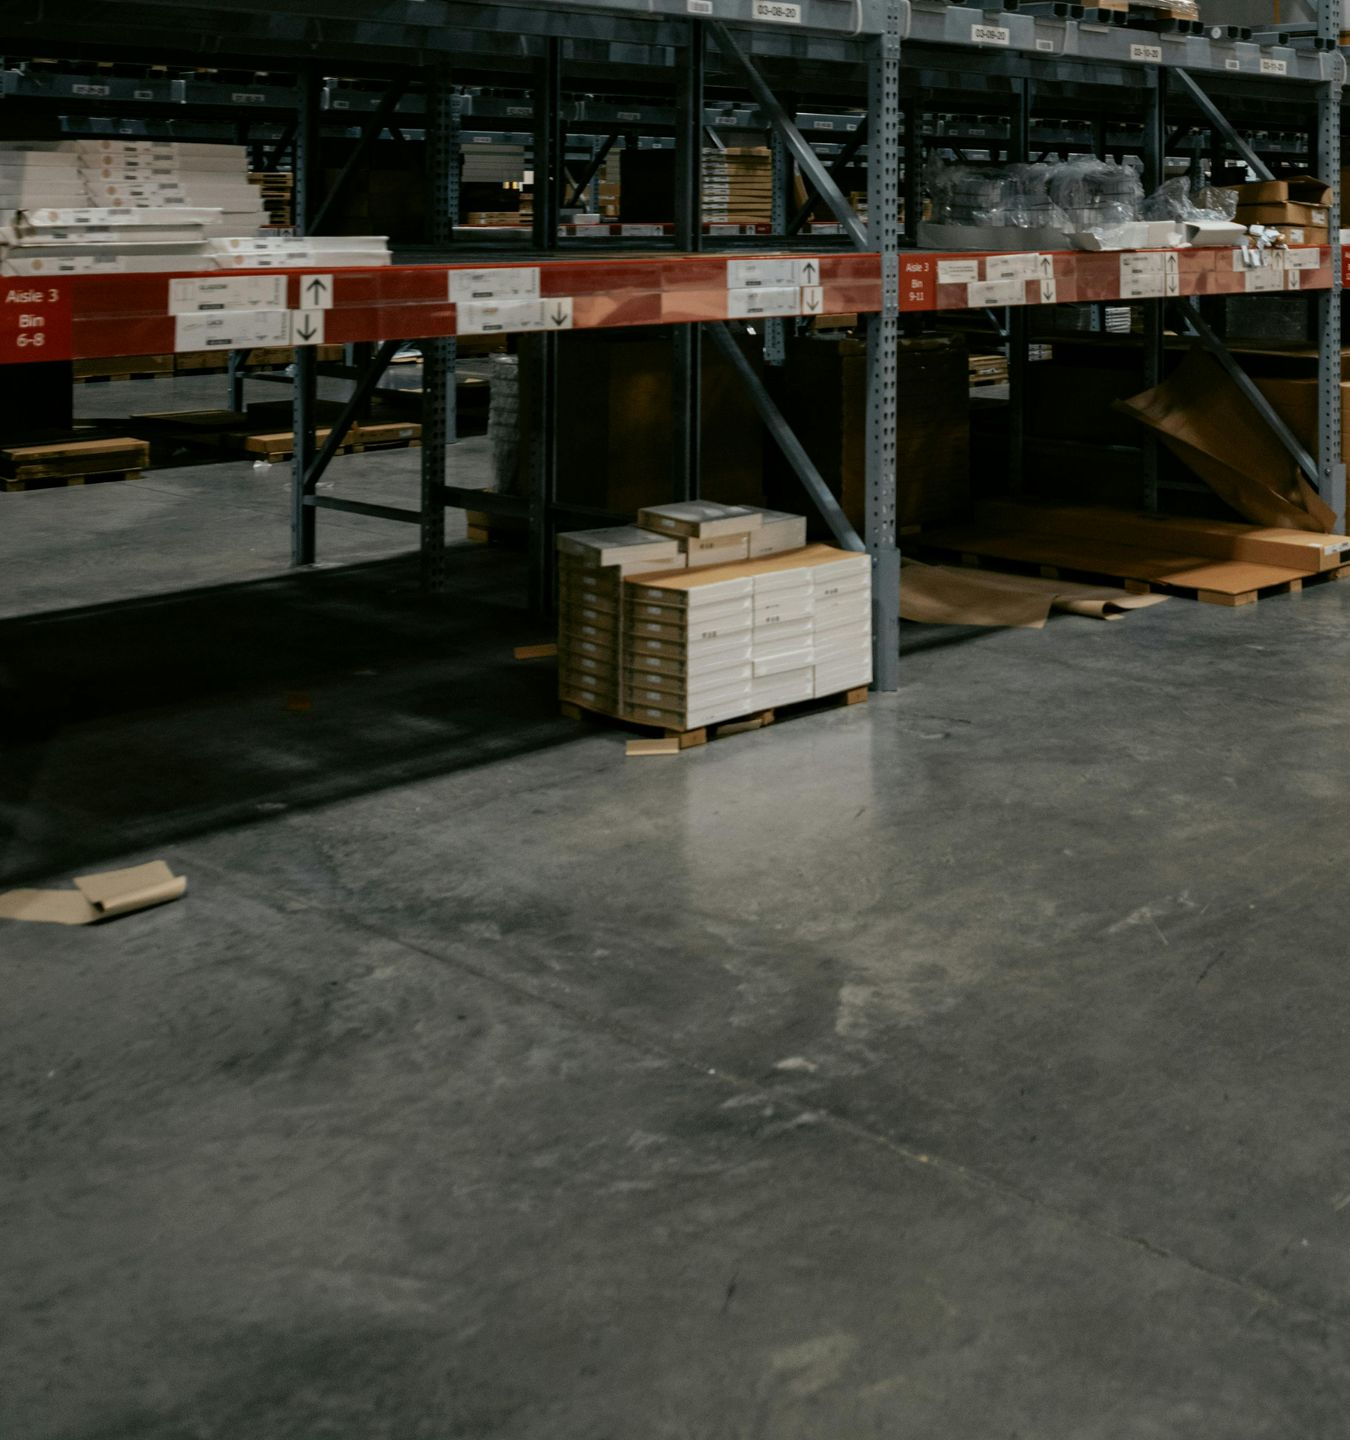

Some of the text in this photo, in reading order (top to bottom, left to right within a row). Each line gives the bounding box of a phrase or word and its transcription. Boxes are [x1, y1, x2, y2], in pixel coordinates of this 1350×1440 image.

[757, 4, 797, 18] 03-08-20
[975, 28, 1006, 41] 03-09-20
[905, 262, 930, 272] Aisle 3
[911, 279, 923, 289] Bin
[5, 288, 59, 303] Aisle 3
[18, 314, 45, 328] Bin
[16, 332, 45, 347] 6-8
